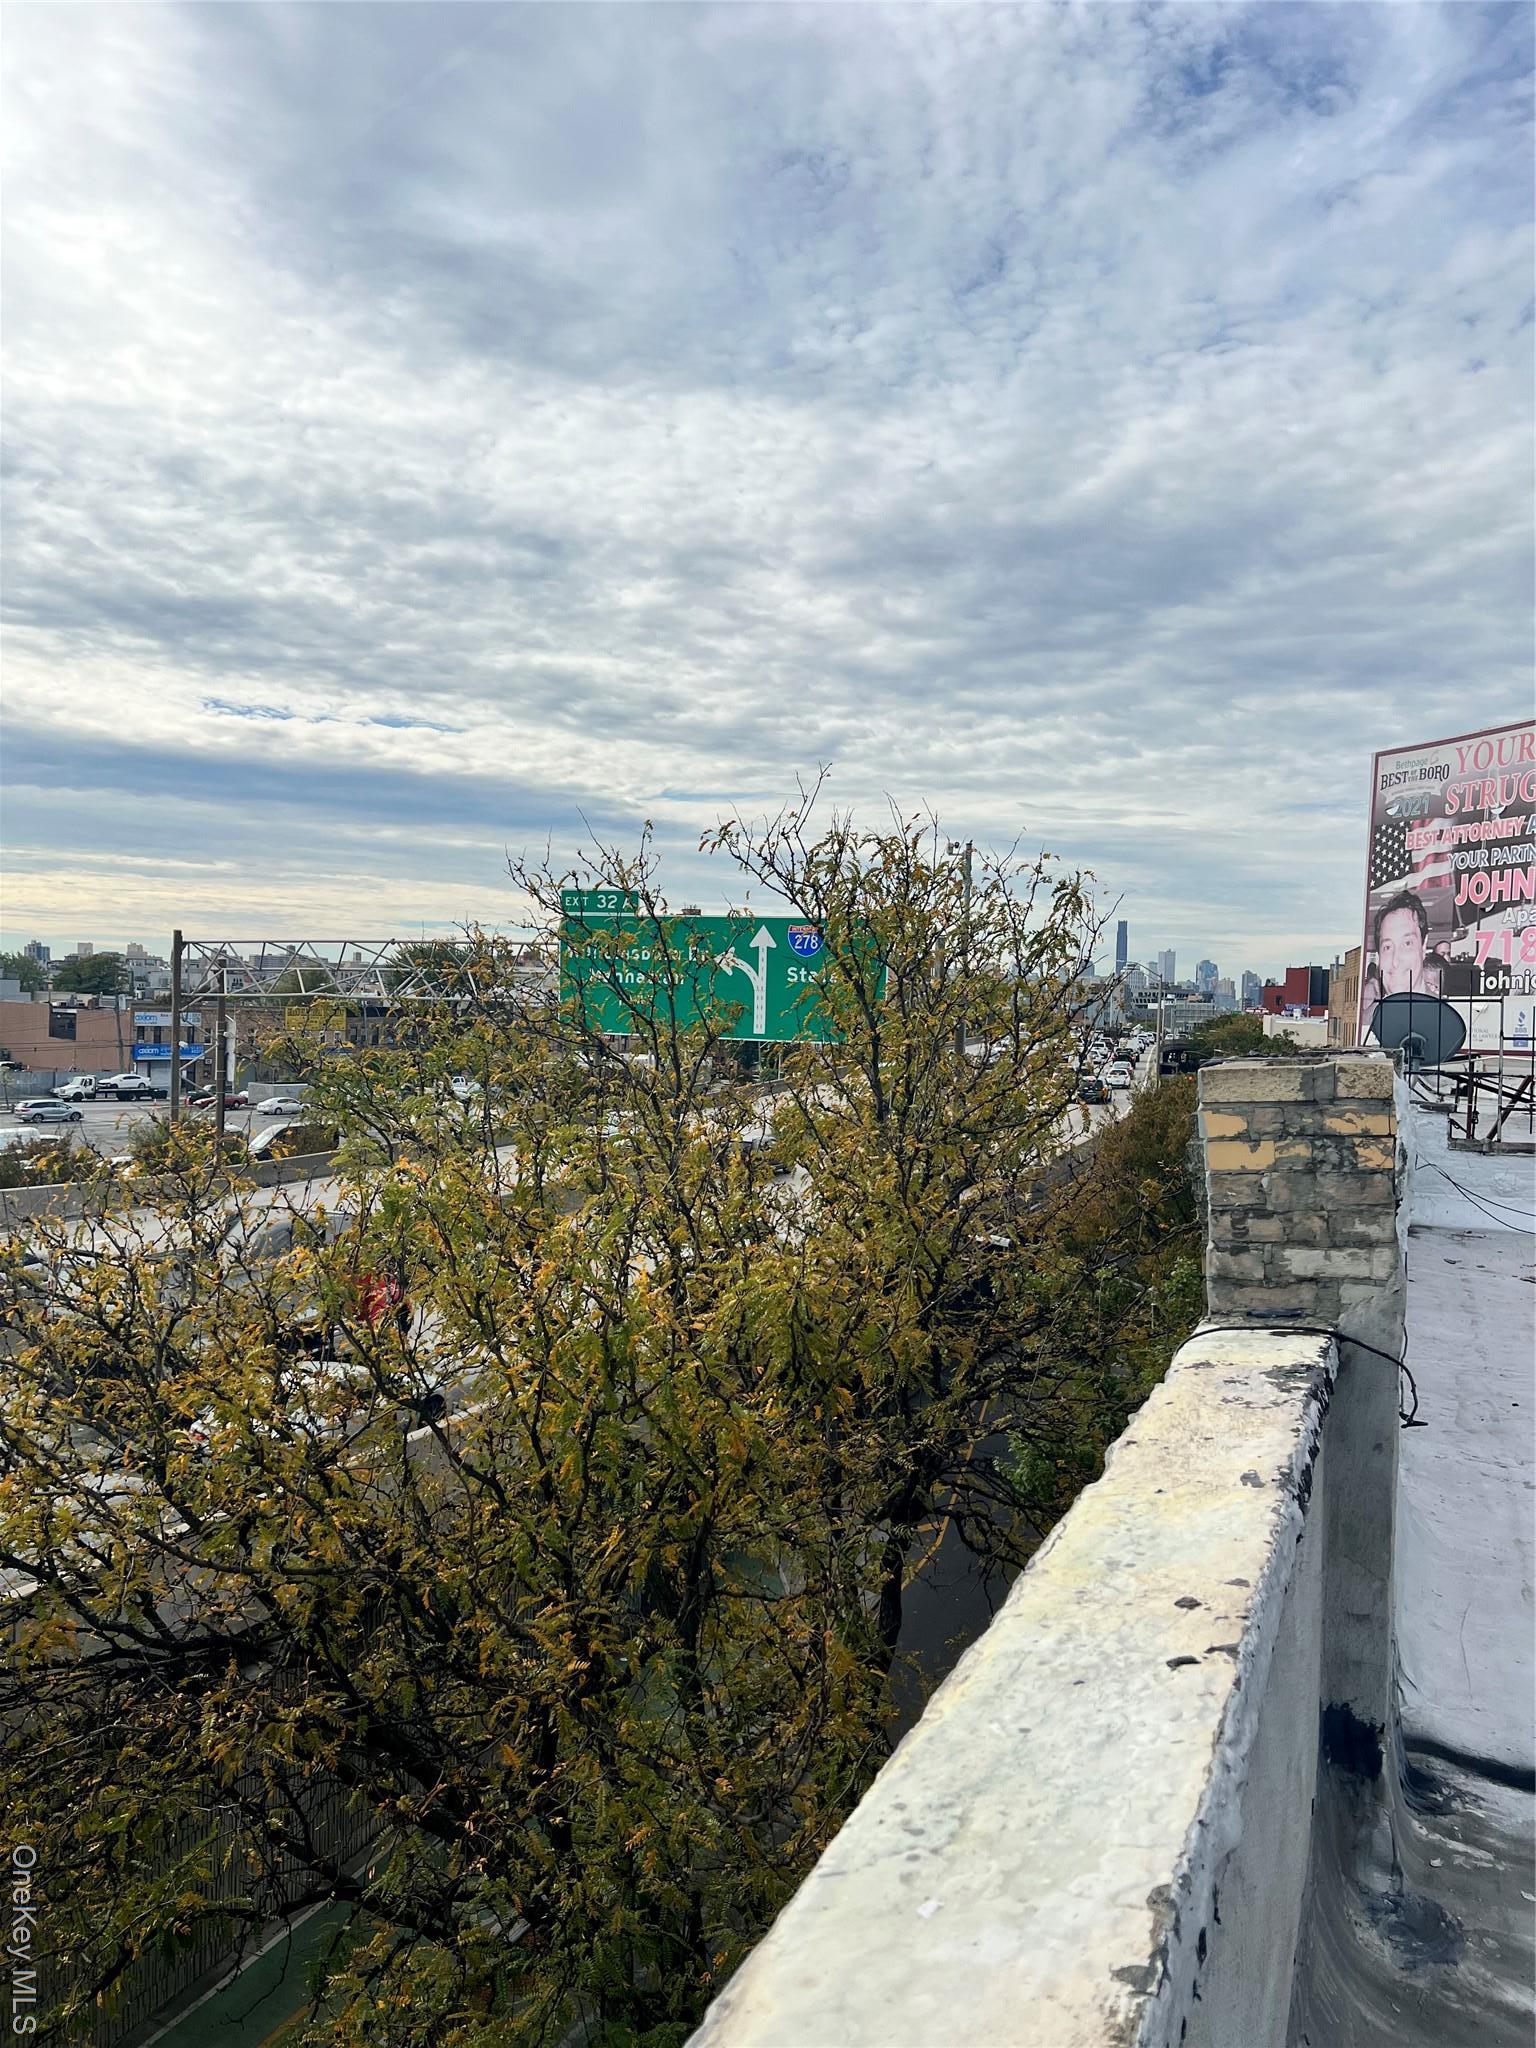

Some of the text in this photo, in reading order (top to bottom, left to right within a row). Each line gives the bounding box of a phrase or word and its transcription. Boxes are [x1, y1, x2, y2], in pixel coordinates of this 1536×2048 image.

[1395, 758, 1428, 770] Bethpage
[1456, 732, 1536, 775] YOUR
[1380, 770, 1408, 790] BEST
[1419, 764, 1450, 782] BORO
[1445, 769, 1536, 815] STRUG
[1392, 792, 1431, 818] 2021
[1405, 829, 1438, 850] BEST
[1440, 816, 1525, 845] ATTORNEY
[1448, 849, 1488, 870] YOUR
[1455, 867, 1536, 905] JOHN
[565, 894, 634, 909] EXT 32 A
[794, 934, 819, 949] 278
[1473, 926, 1536, 966] 718
